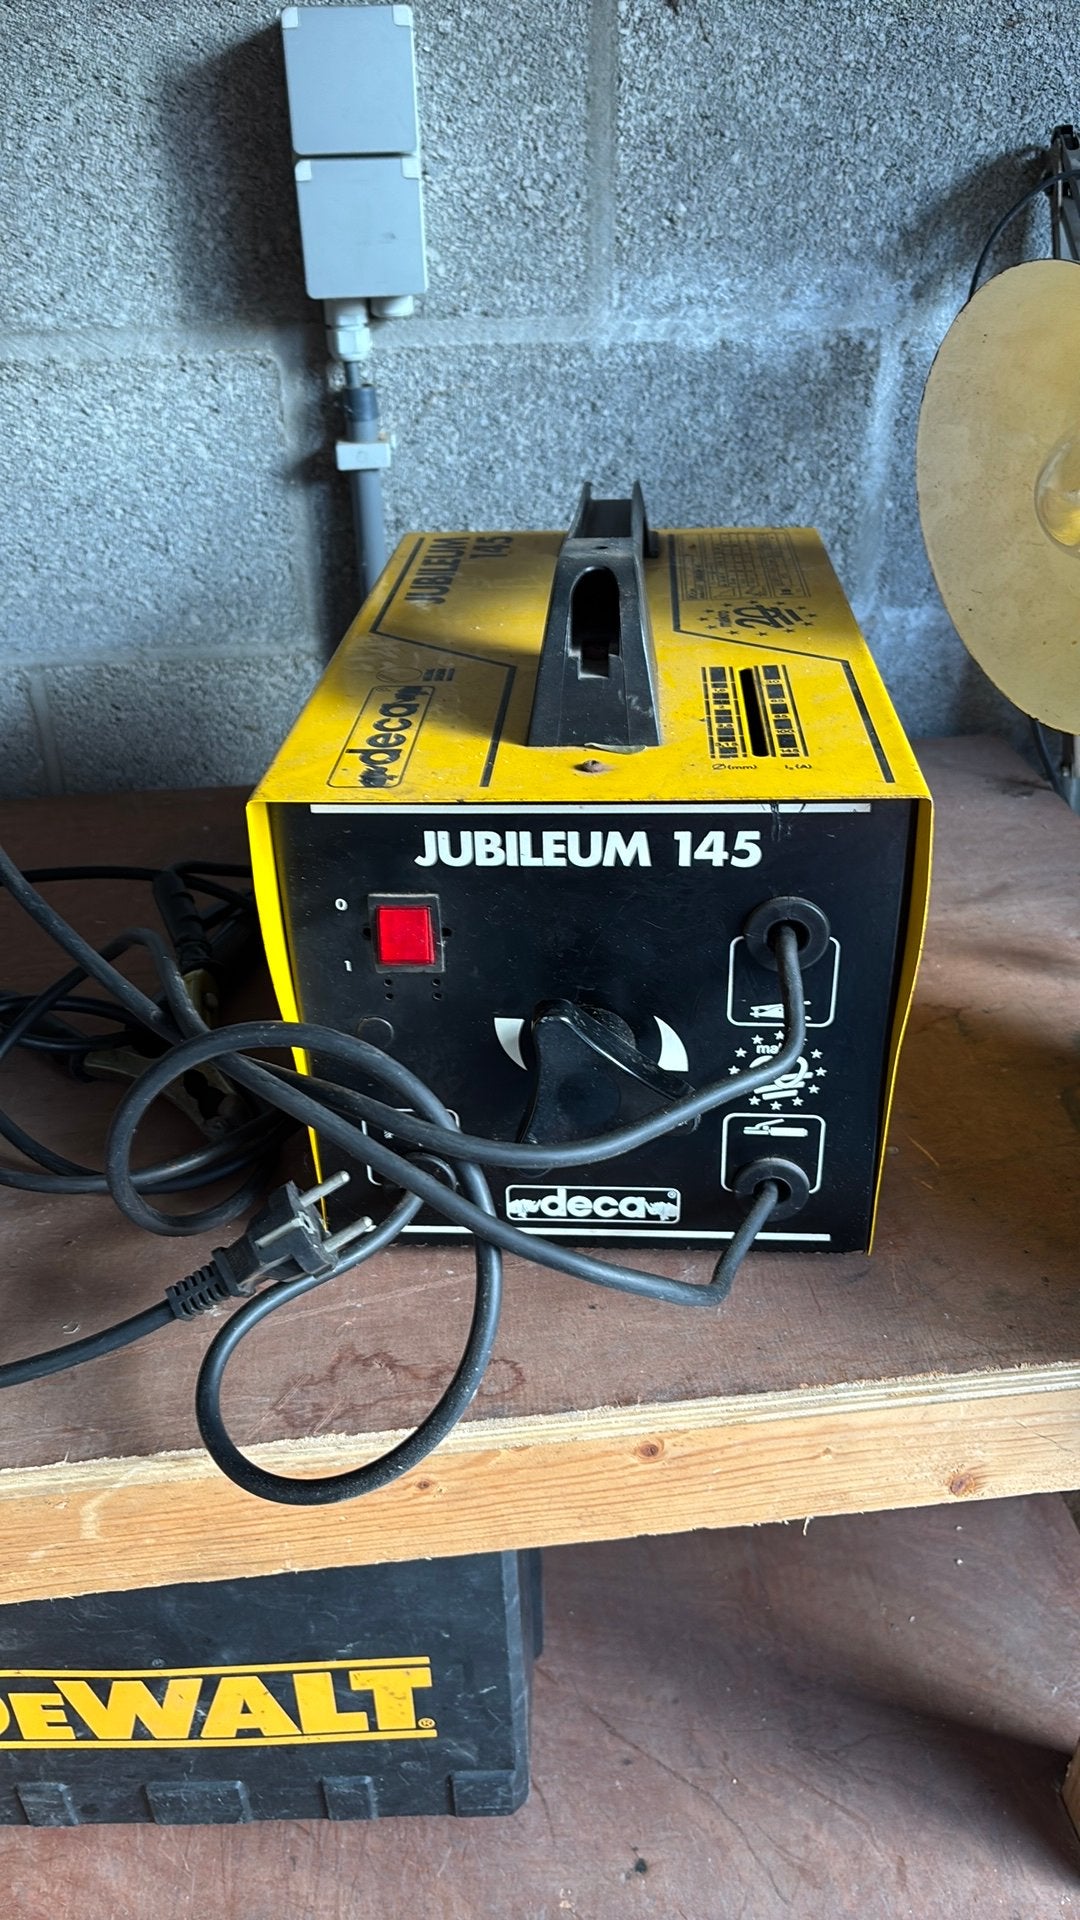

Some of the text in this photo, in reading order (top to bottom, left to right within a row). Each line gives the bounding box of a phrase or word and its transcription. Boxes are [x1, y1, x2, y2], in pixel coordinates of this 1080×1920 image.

[404, 537, 470, 604] JUBILEUM
[469, 536, 513, 559] 145
[345, 702, 420, 765] deca
[414, 831, 763, 867] JUBILEUM 145
[540, 1187, 646, 1218] deca
[0, 1667, 432, 1740] EWALT
